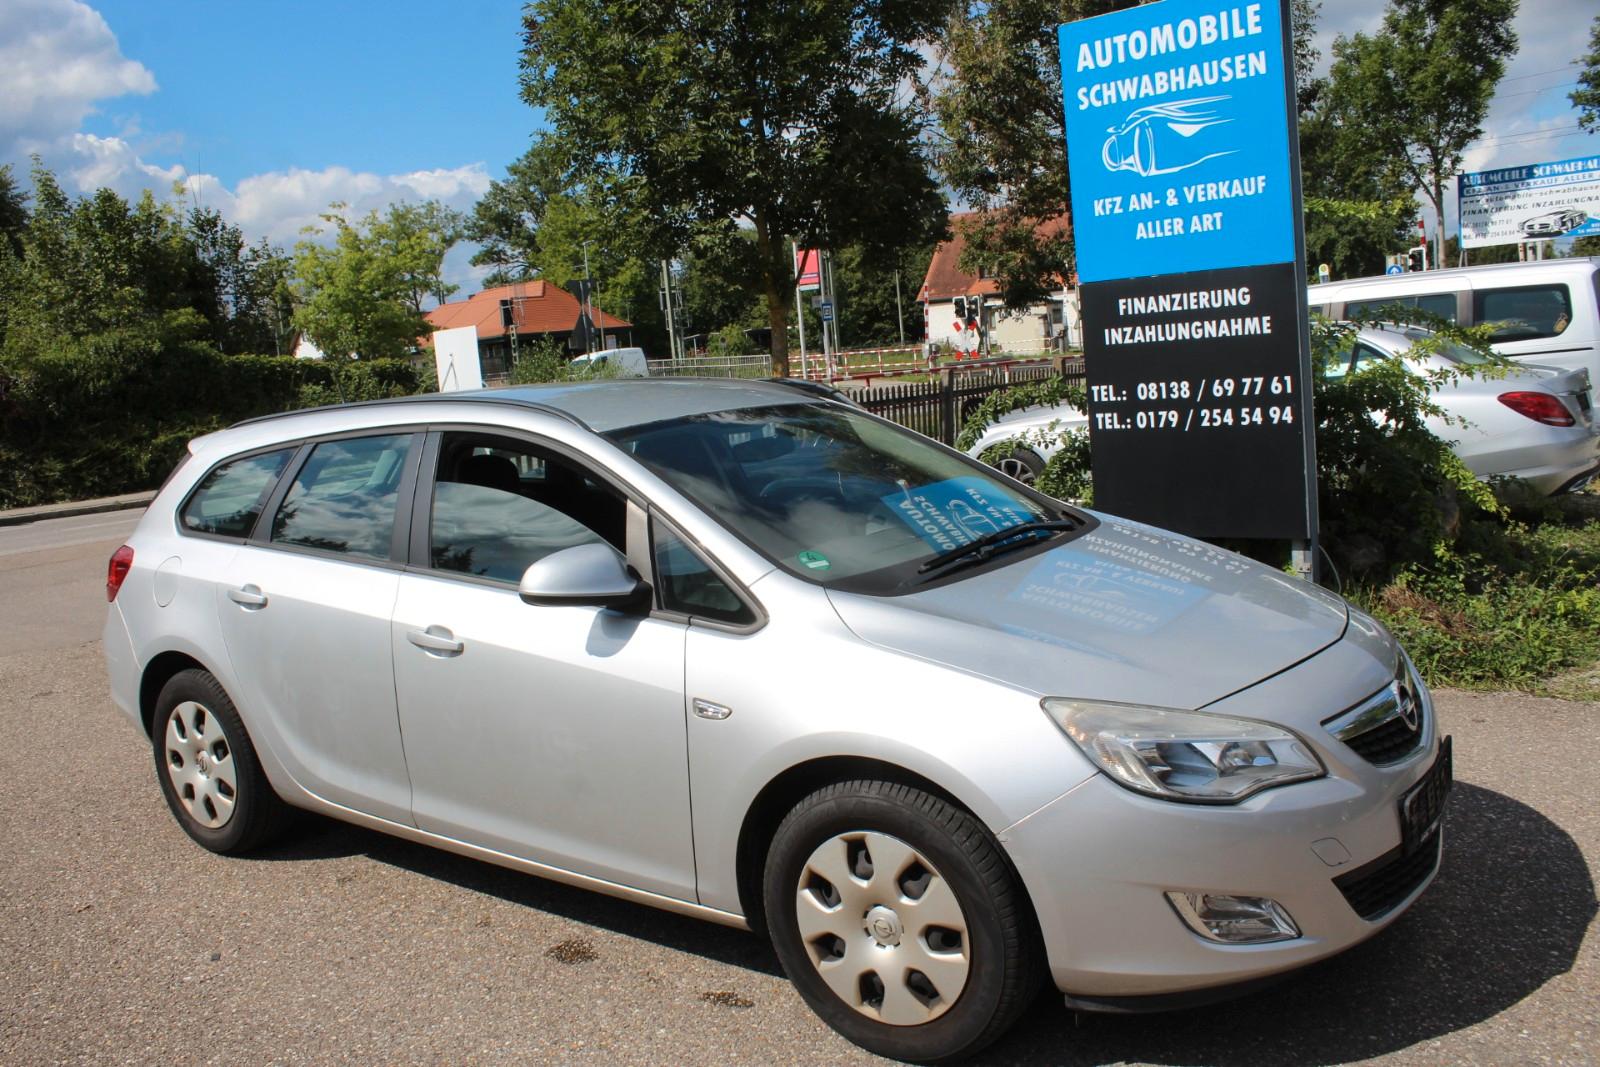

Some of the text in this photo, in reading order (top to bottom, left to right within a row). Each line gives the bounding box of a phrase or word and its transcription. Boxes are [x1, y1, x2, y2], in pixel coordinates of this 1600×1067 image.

[1077, 3, 1262, 72] AUTOMOBILE
[1077, 51, 1267, 110] SCHWABHAUSEN
[1094, 175, 1266, 217] KFZ AN- & VERKAUF
[1136, 212, 1223, 240] ALLER ART
[1118, 287, 1251, 315] FINANZIERUNG
[1104, 316, 1272, 345] INZAHLUNGNAHME
[1091, 375, 1292, 402] TEL.: 08138 / 69 77 61
[1096, 406, 1293, 431] TEL.: 0179 / 254 54 94
